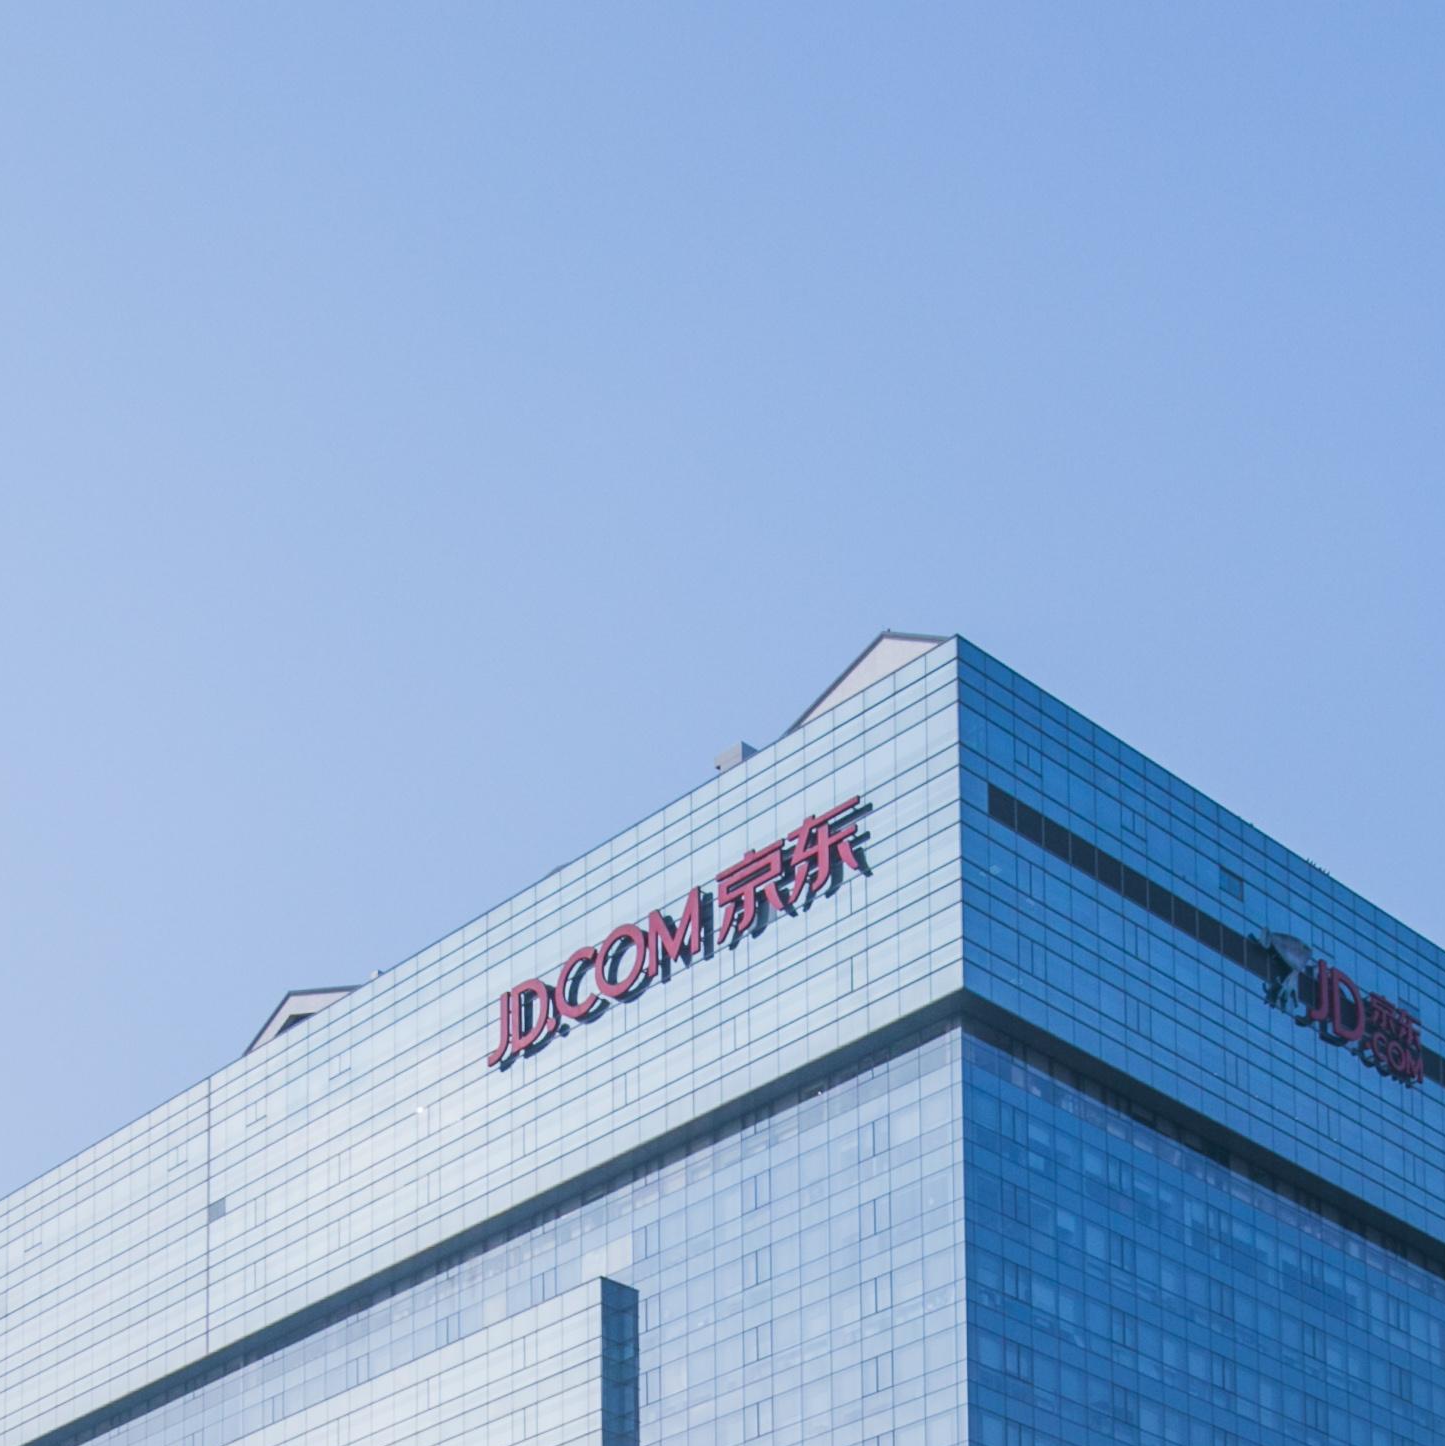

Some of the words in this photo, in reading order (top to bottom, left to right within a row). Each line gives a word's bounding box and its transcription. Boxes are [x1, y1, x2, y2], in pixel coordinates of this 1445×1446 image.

[487, 885, 703, 1068] JD.COM
[715, 794, 861, 944] 京东
[1310, 959, 1366, 1042] JD
[1368, 991, 1422, 1050] 京东
